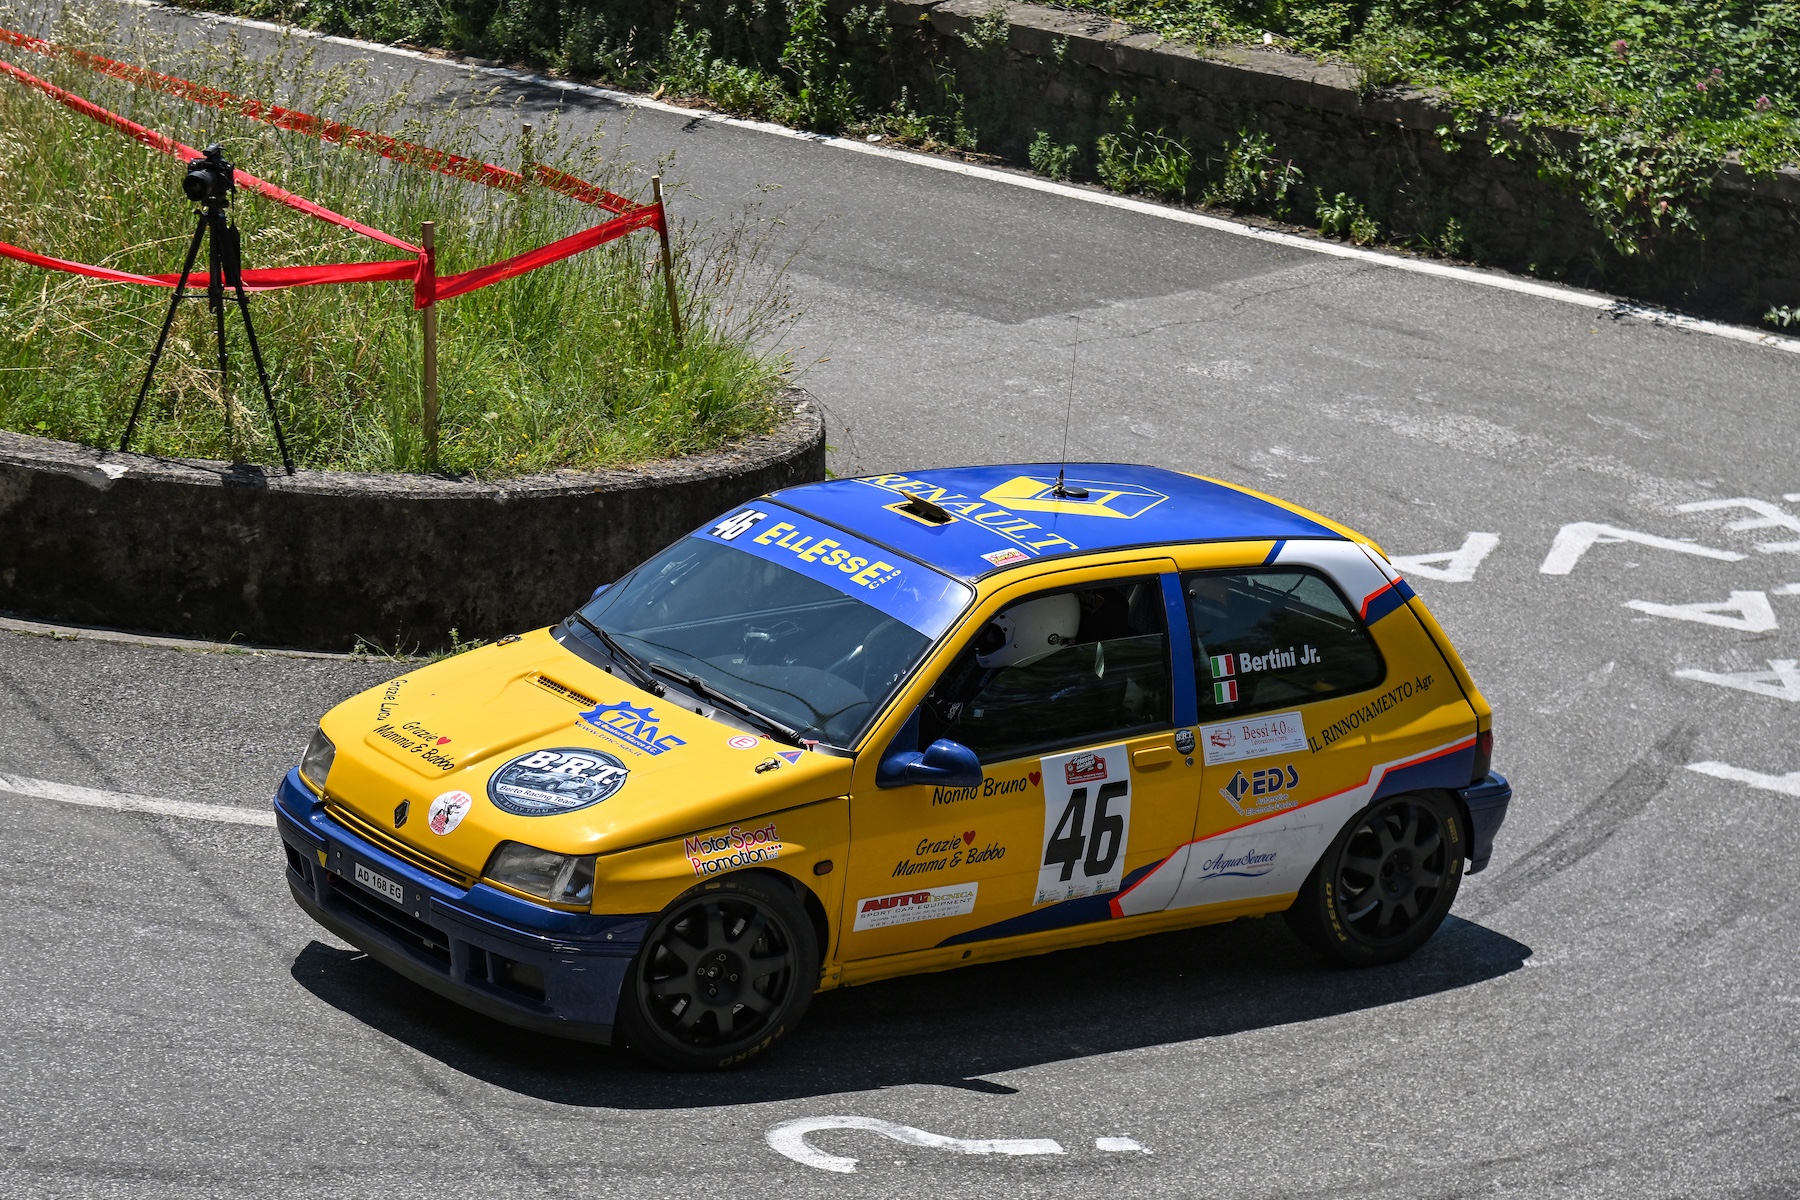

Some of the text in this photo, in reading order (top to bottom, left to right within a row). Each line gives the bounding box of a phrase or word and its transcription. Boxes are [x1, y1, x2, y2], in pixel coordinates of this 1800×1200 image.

[712, 509, 769, 541] 46
[857, 473, 1079, 550] RENAULT
[1239, 644, 1321, 673] Bertini Jr.
[1308, 735, 1321, 754] IL
[1320, 682, 1413, 745] RINNOVAMENTO
[1415, 674, 1435, 692] Agr.
[402, 721, 438, 742] Grazie
[608, 711, 687, 752] TMC
[734, 737, 753, 746] E
[1242, 724, 1269, 740] Bessi
[1271, 721, 1287, 736] 4.0
[373, 724, 455, 771] Mamma & Babbo
[517, 750, 631, 785] B.R.T.
[1253, 765, 1299, 795] EDS
[500, 785, 577, 806] Berto Racing Team
[932, 777, 1027, 806] Nonno Bruno
[1256, 793, 1288, 805] Automotive
[1246, 800, 1298, 816] Electronic Devices
[684, 823, 779, 859] MotorSport
[1043, 779, 1129, 882] 46
[892, 843, 1006, 878] Mamma & Babbo
[916, 835, 962, 857] Grazie
[691, 848, 769, 876] Promotion
[358, 868, 402, 899] AD 168 EG
[860, 909, 892, 919] SPORT
[895, 906, 914, 914] CAR
[917, 897, 973, 910] EQUIPMENT
